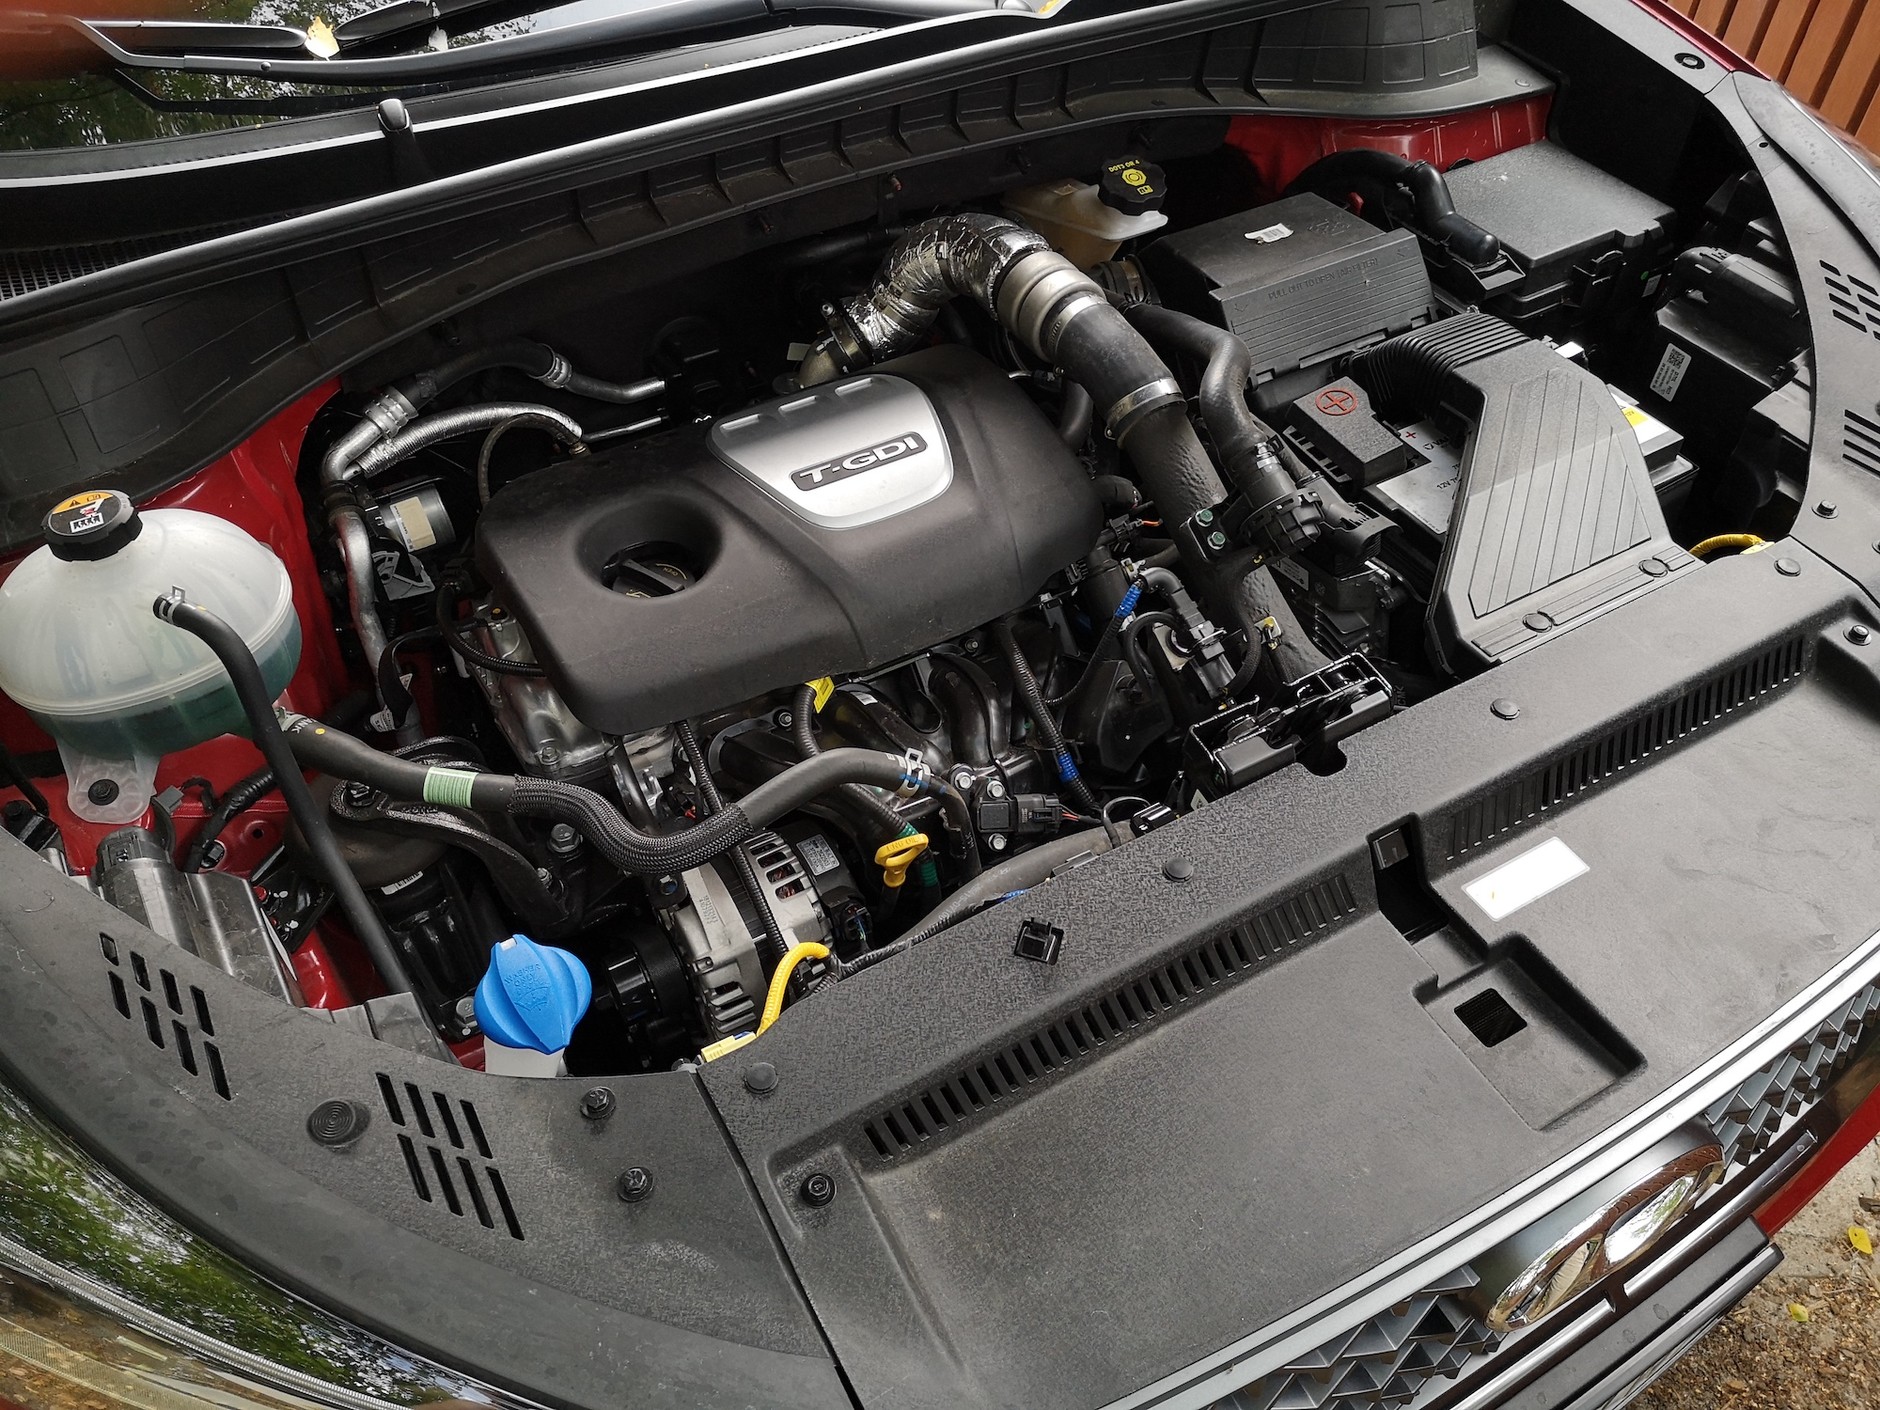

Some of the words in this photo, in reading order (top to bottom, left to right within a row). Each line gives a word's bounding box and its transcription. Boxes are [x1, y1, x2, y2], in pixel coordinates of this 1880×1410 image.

[1107, 163, 1125, 173] DOT3
[1125, 160, 1135, 168] OR
[1289, 282, 1302, 294] OUT
[1304, 277, 1314, 287] TO
[1314, 272, 1336, 285] OPEN
[799, 436, 920, 484] T-GDI
[905, 836, 919, 846] OIL
[504, 963, 541, 985] WASHER
